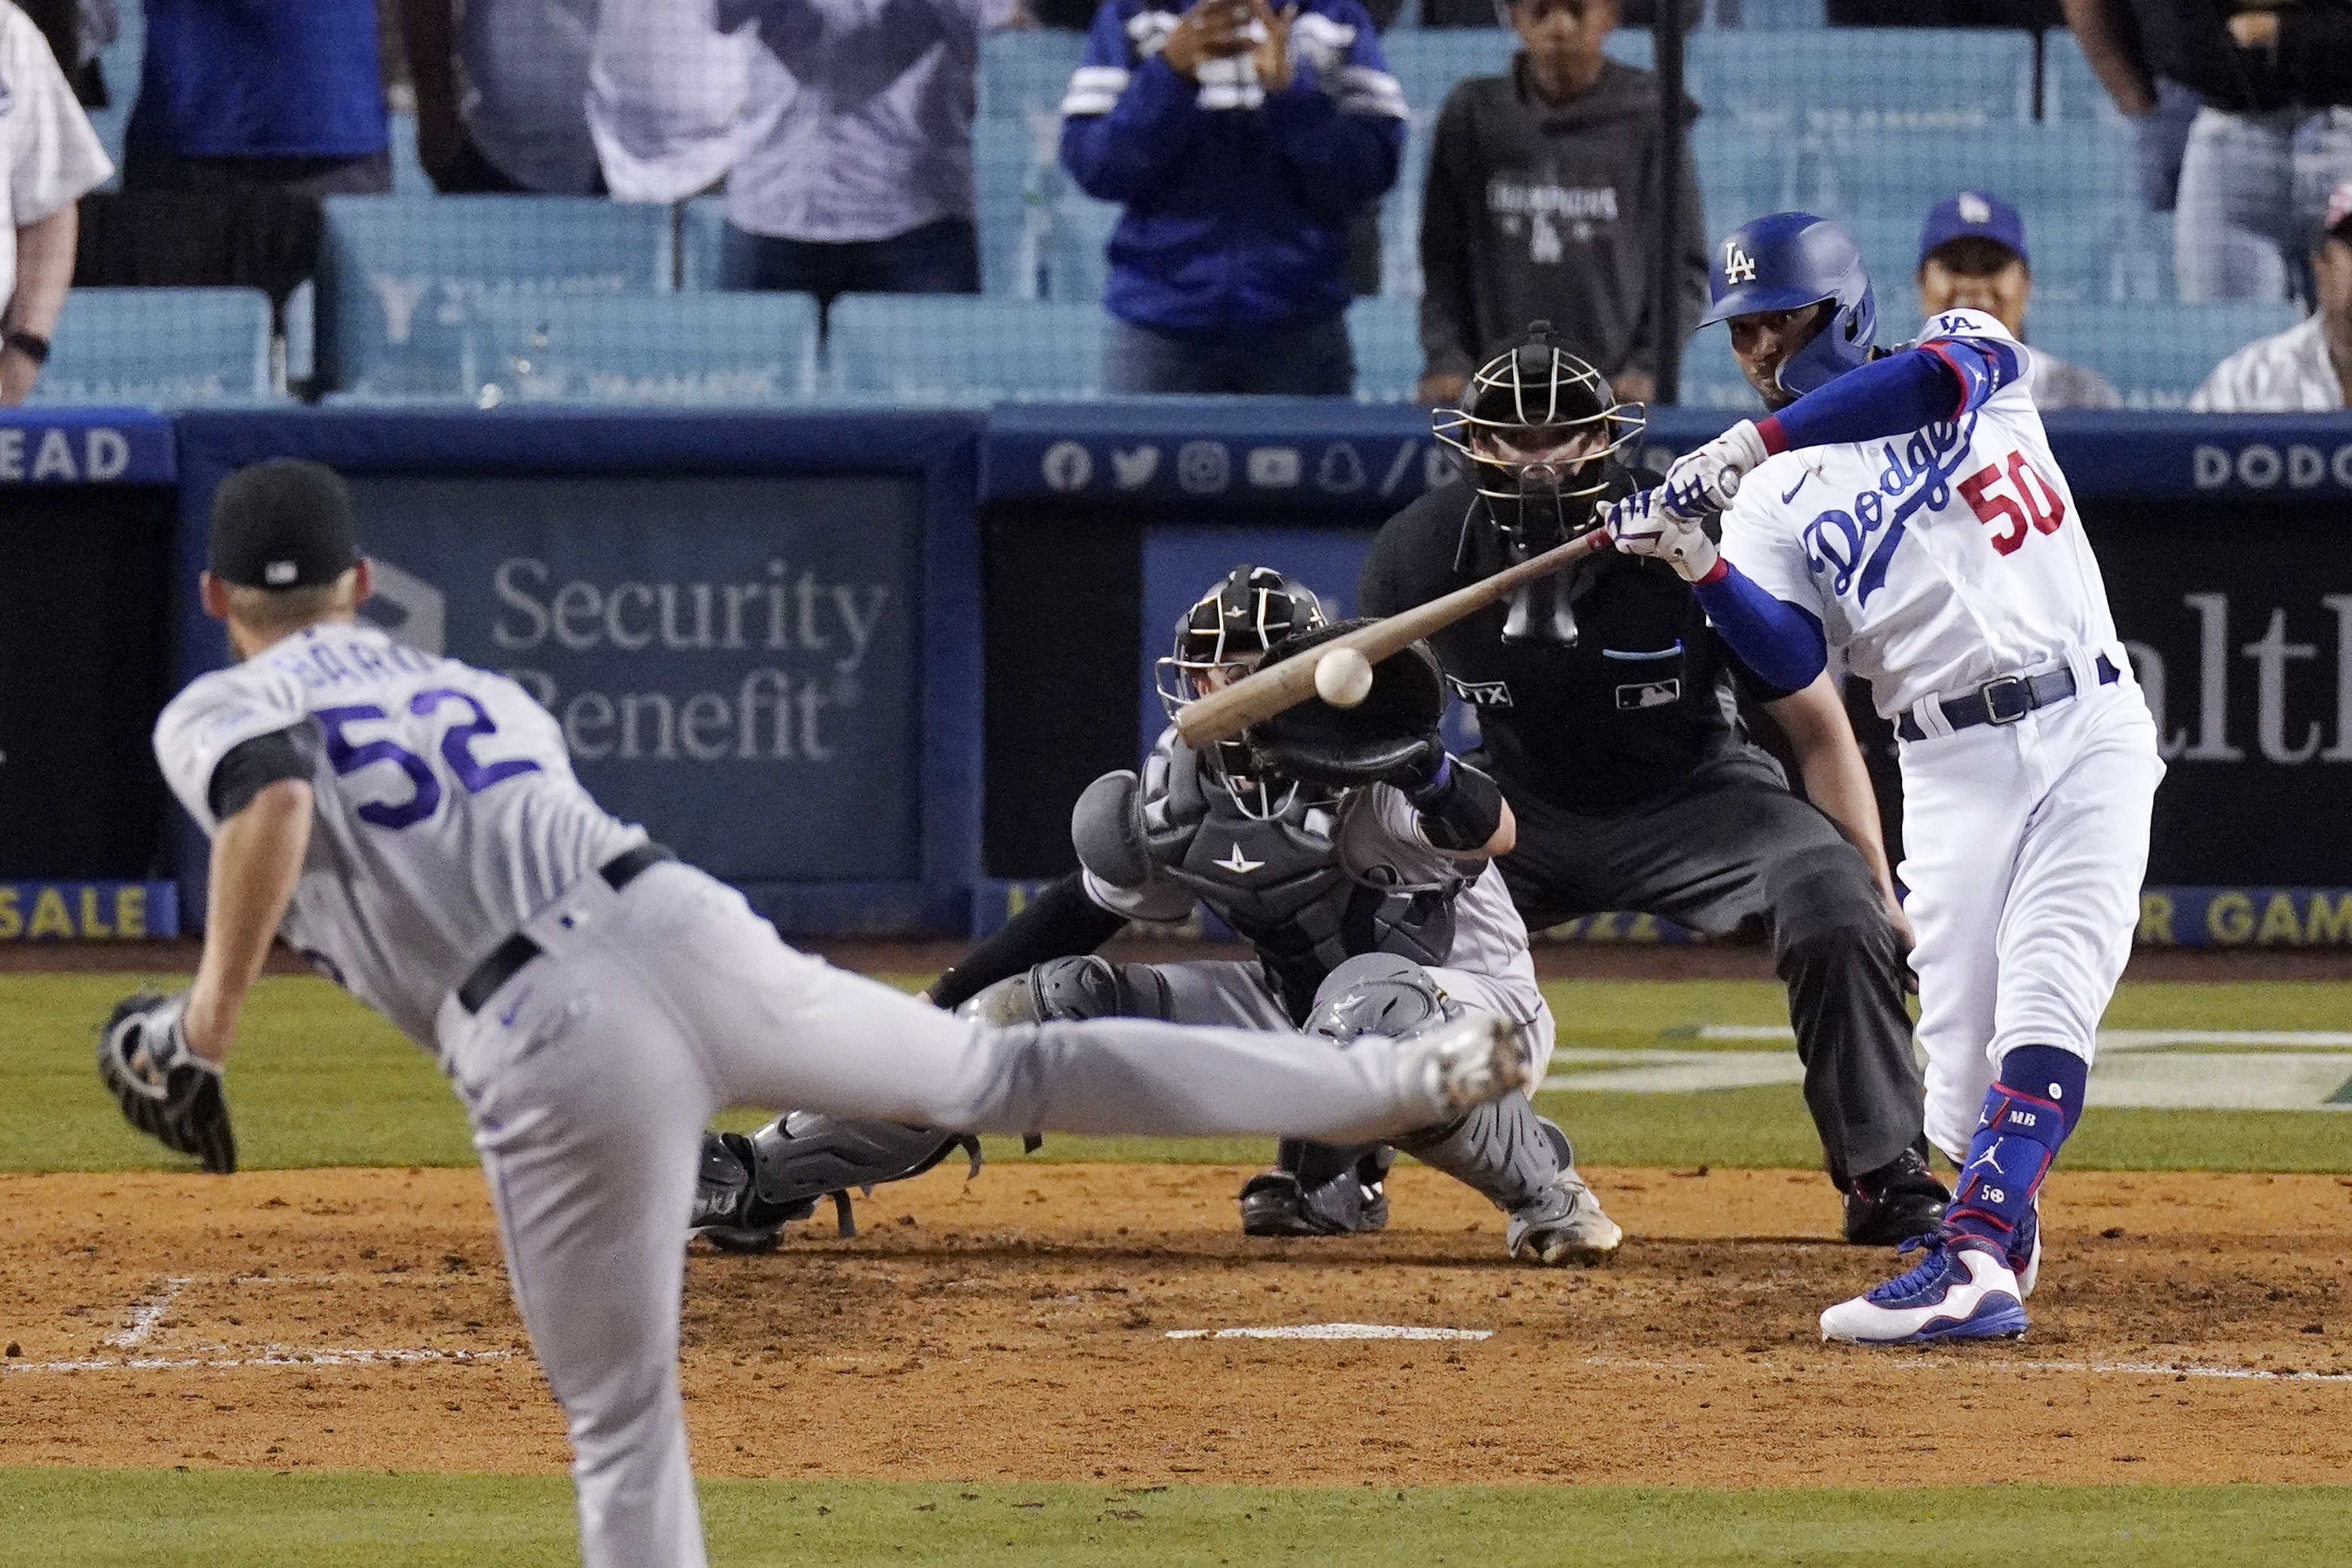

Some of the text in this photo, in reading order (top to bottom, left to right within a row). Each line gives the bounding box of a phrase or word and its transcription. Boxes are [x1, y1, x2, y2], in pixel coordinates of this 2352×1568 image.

[1725, 242, 1756, 284] LA
[1957, 450, 2066, 556] 50
[494, 557, 891, 672] Security
[312, 688, 540, 830] 52
[2008, 1110, 2036, 1126] MB
